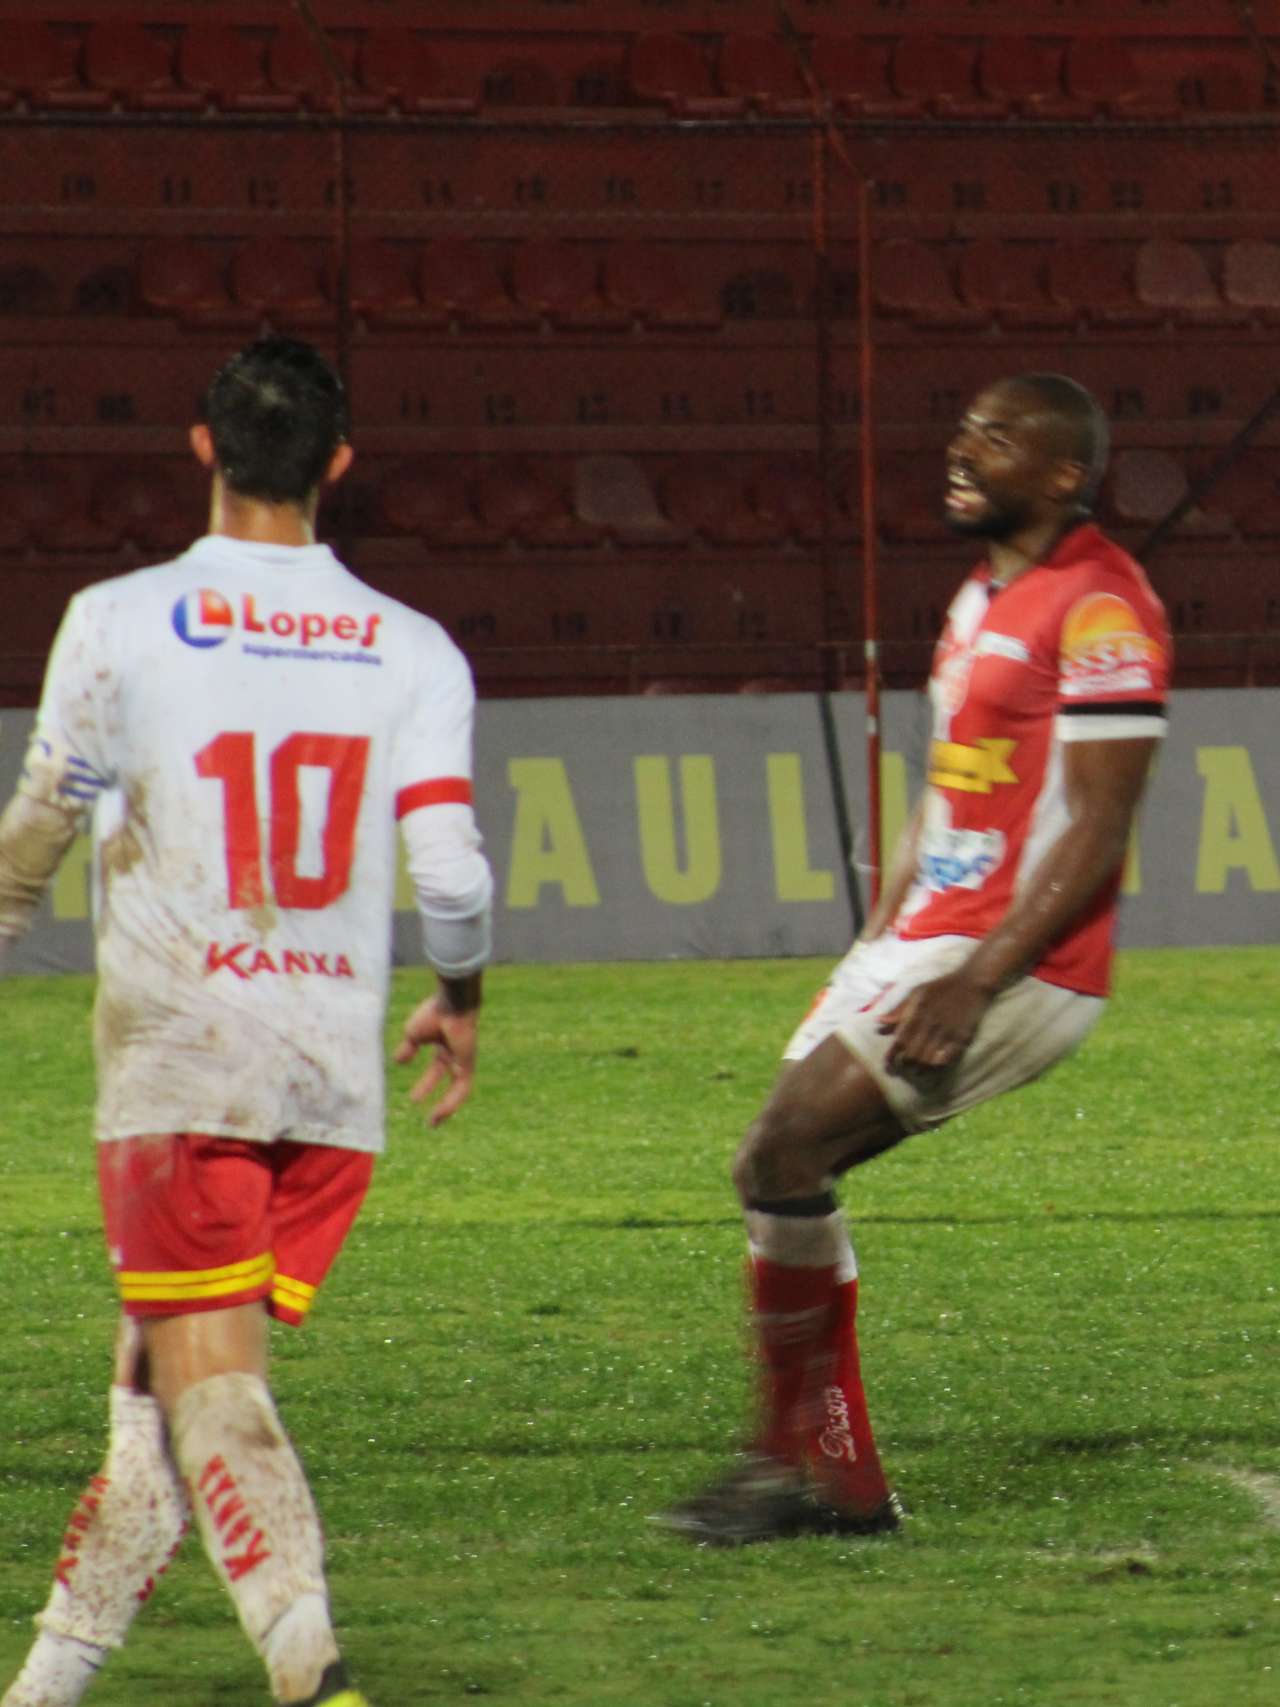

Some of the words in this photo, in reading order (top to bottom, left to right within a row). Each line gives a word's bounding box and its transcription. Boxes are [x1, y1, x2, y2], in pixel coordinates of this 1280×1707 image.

[241, 592, 382, 648] Lopes
[192, 730, 371, 911] 10
[202, 941, 356, 981] KANXA
